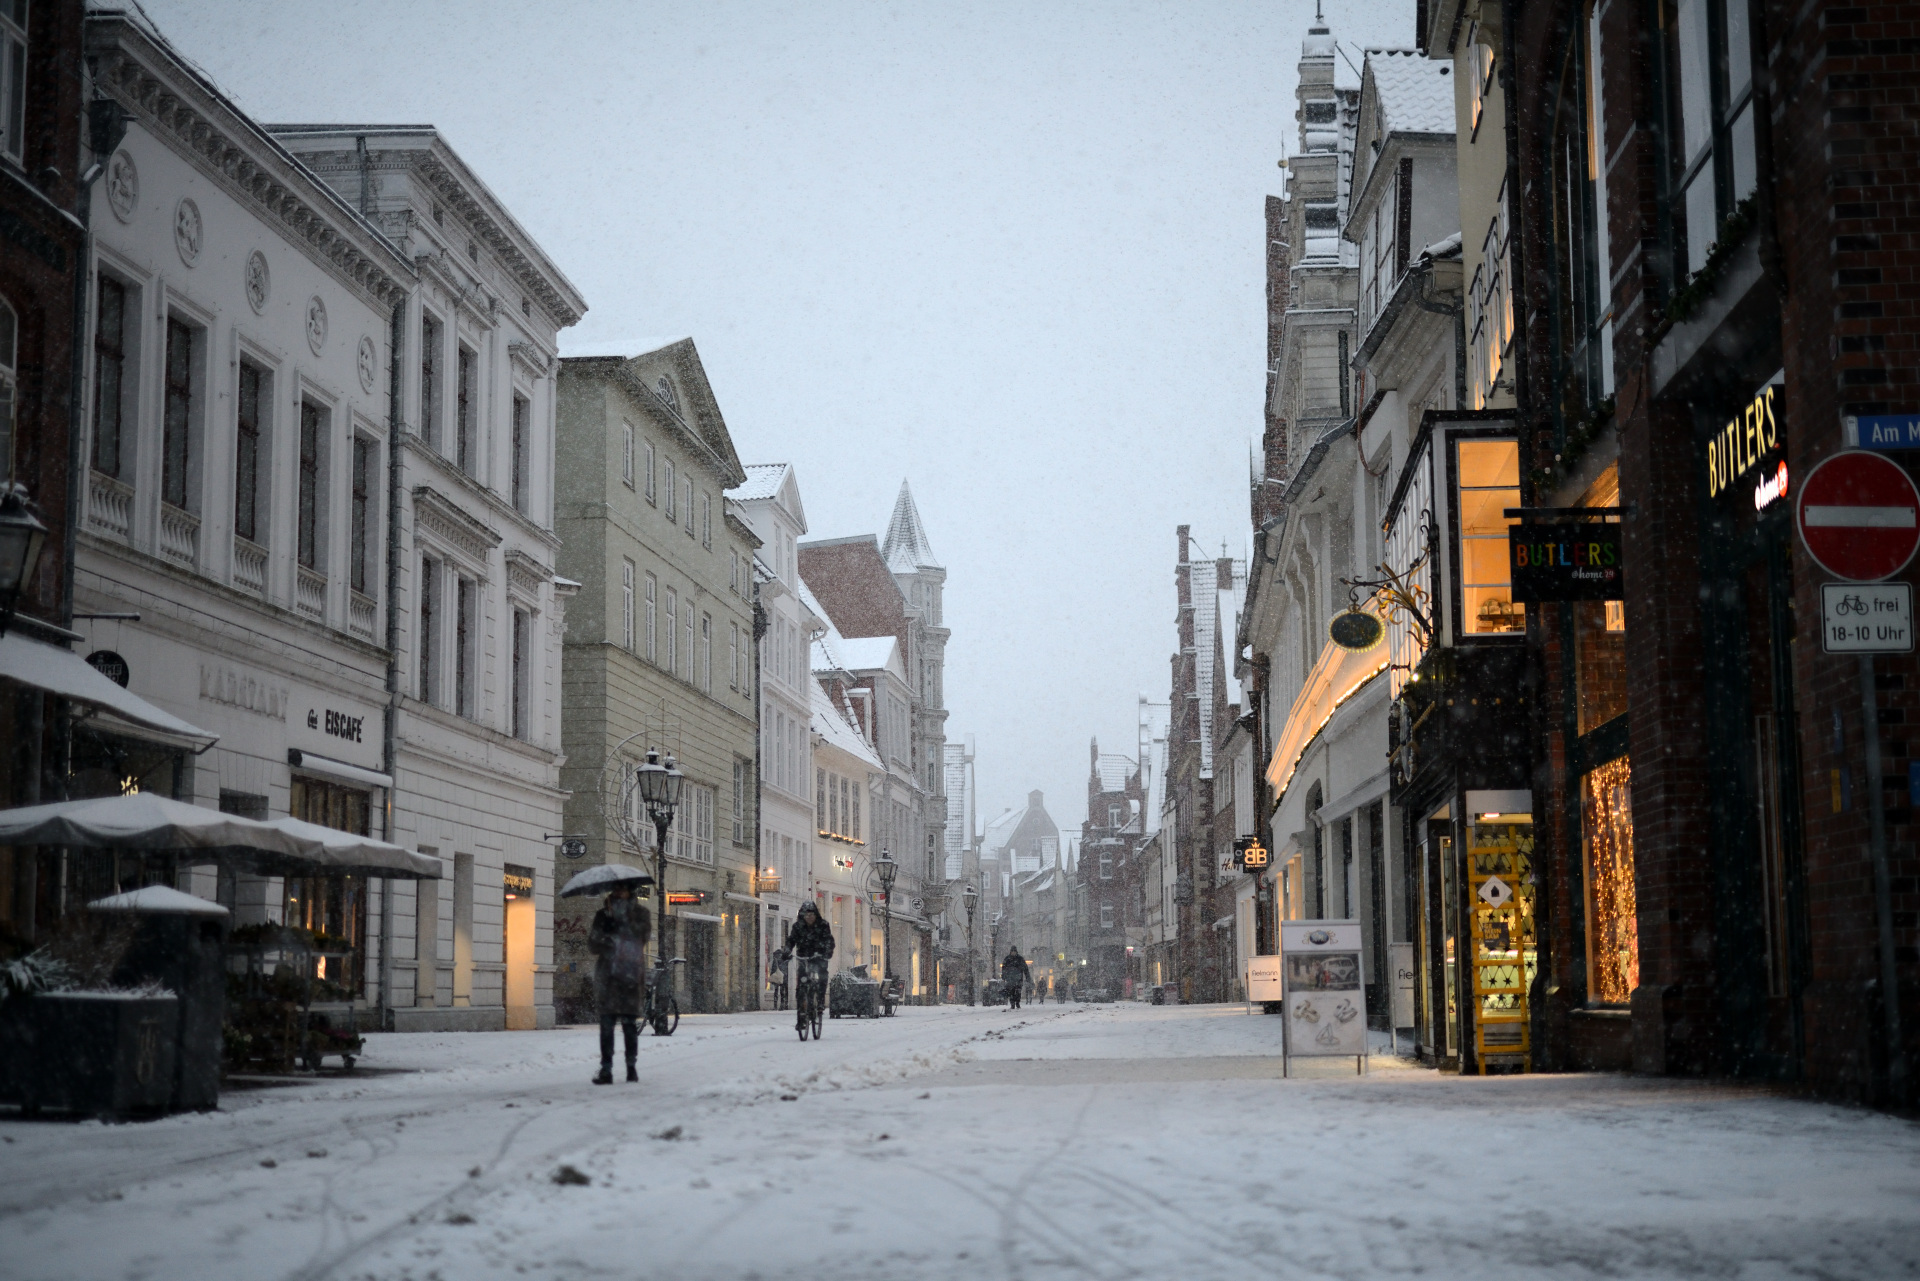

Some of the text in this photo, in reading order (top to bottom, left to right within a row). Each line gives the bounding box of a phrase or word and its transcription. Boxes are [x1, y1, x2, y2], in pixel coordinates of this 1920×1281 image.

[1872, 421, 1900, 443] Am
[1516, 541, 1615, 567] BUTLERS
[1873, 597, 1899, 612] frei
[1831, 625, 1905, 641] 18-10 Uhr
[325, 709, 365, 743] EISCAFÉ
